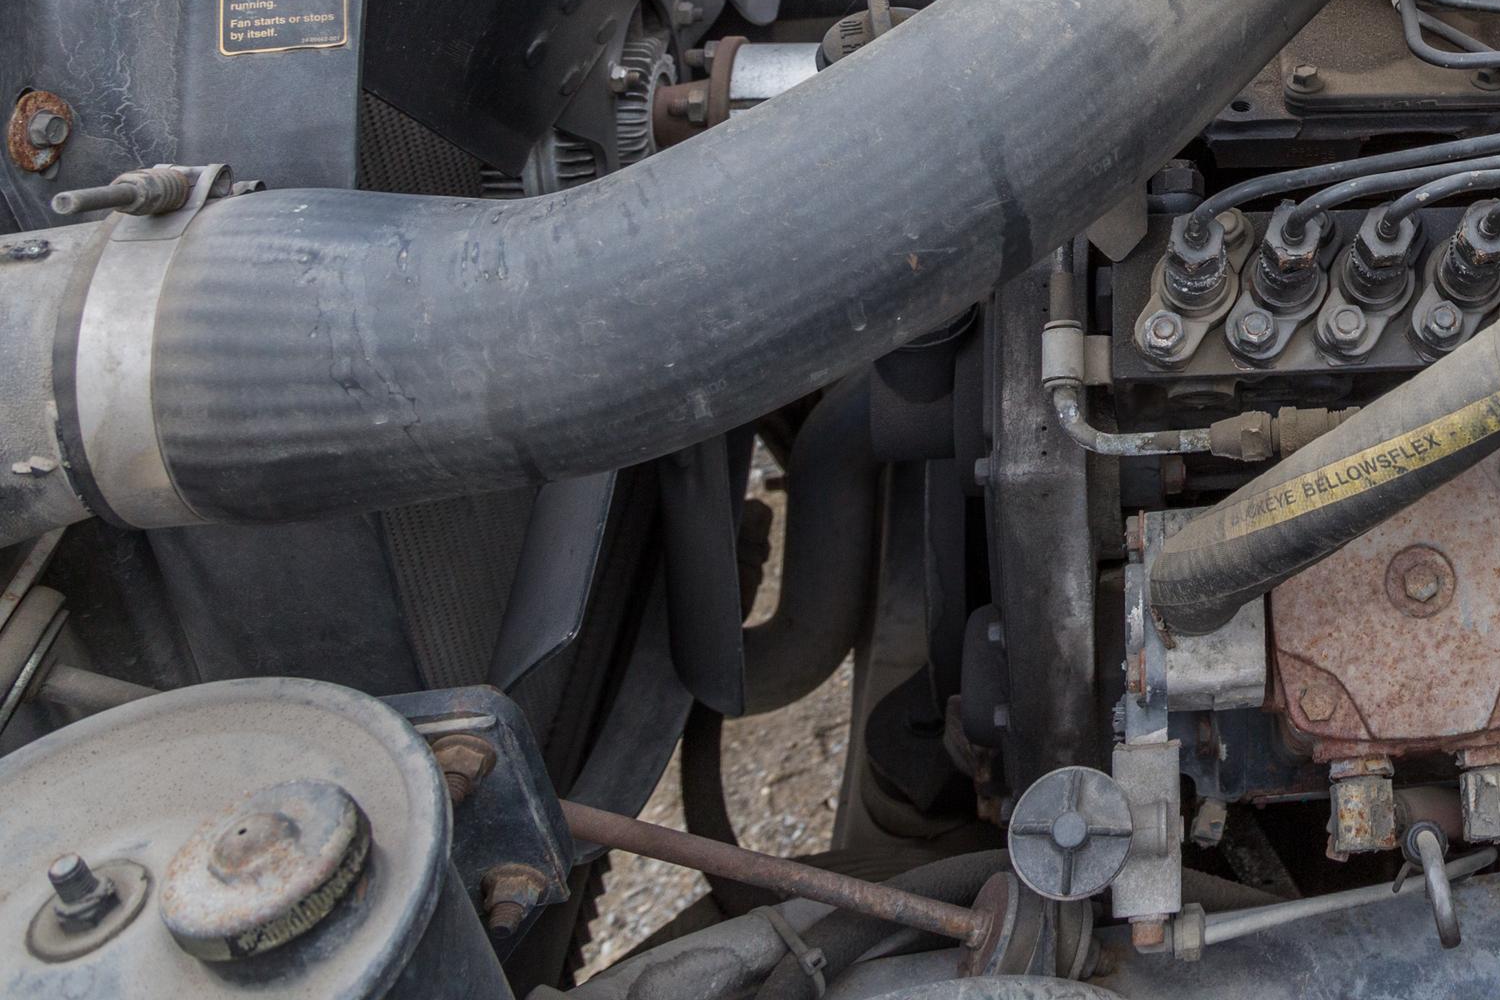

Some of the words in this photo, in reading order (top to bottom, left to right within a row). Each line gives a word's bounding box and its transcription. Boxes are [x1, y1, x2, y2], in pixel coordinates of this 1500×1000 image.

[230, 0, 277, 11] running.
[230, 18, 252, 29] Fan
[254, 15, 286, 27] starts
[288, 15, 301, 24] or
[303, 12, 335, 24] stops
[230, 30, 244, 41] by
[247, 27, 278, 39] itself.
[1302, 431, 1442, 499] BELLOWSFLEX
